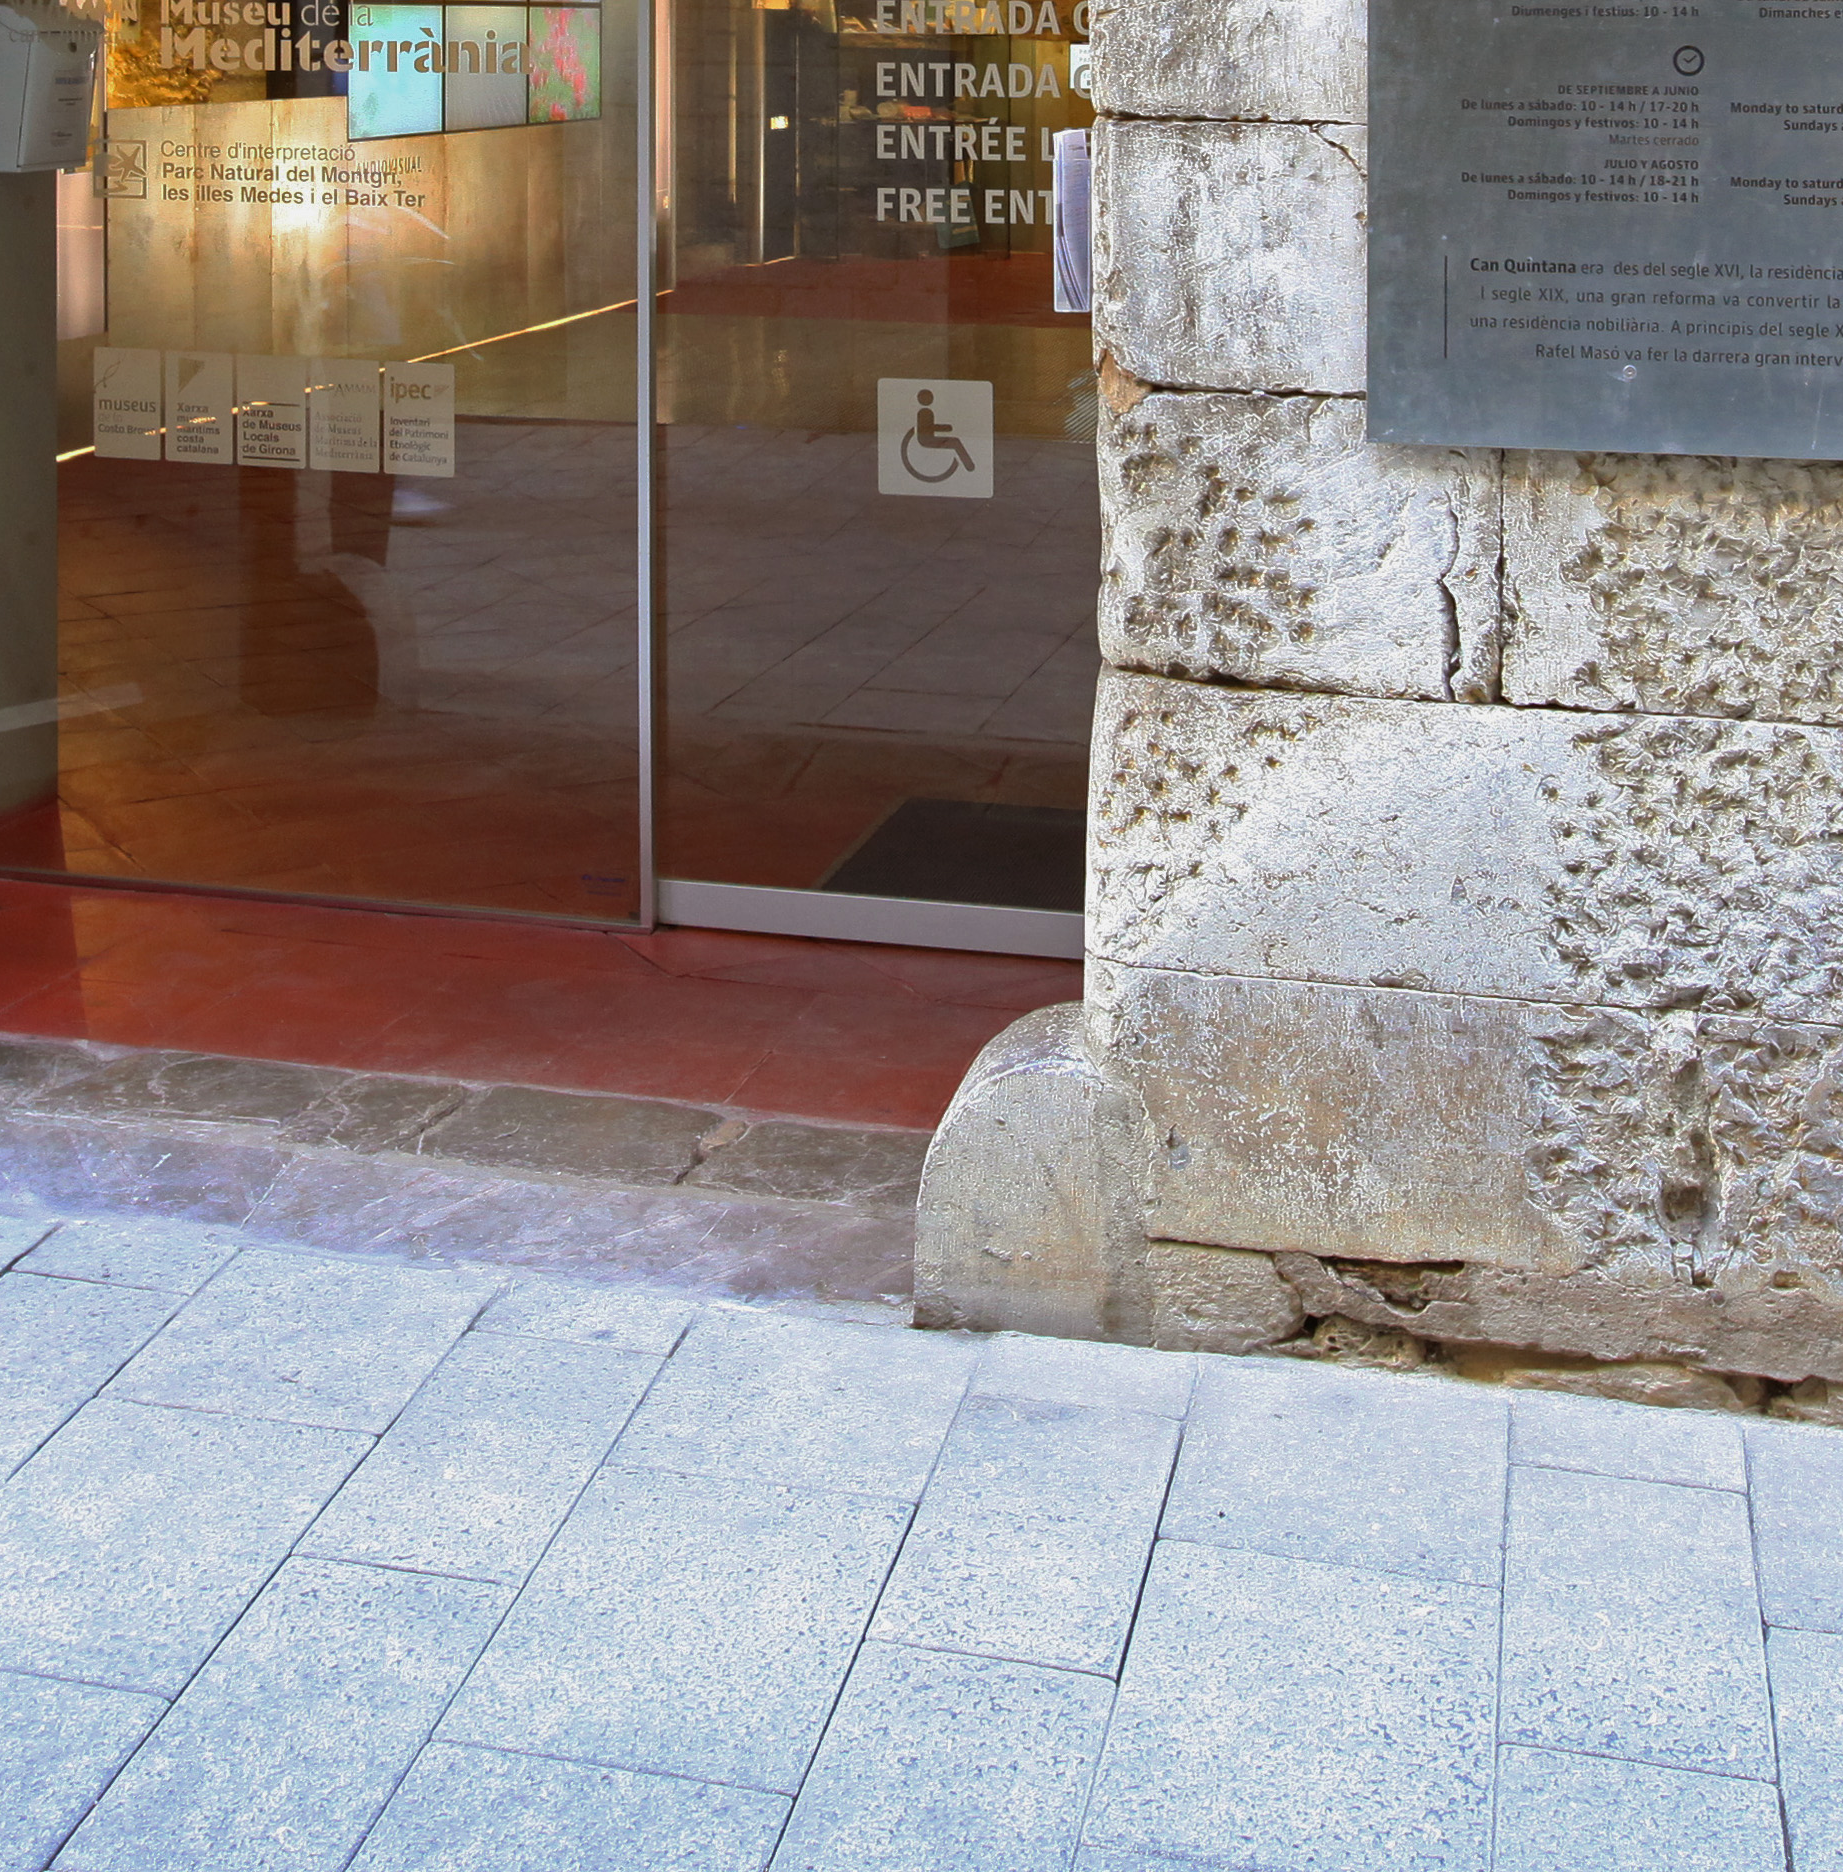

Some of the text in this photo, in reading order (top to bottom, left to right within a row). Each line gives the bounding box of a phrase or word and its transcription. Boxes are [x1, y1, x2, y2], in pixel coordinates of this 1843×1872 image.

[876, 0, 1062, 35] ENTRADA
[160, 27, 533, 74] Mediterrània
[876, 62, 1062, 99] ENTRADA
[1558, 85, 1699, 96] DE SEPTIEMBRE A JUNIO
[876, 117, 1026, 162] ENTRÉE
[1609, 134, 1699, 146] Martes cerrado
[160, 140, 356, 164] Centre d'interpretació
[1604, 159, 1699, 170] JULIO Y AGOSTO
[162, 162, 402, 188] Parc Natural del Montgrí,
[162, 184, 426, 208] les illes Medes i el Baix Ter
[876, 187, 971, 224] FREE
[1470, 258, 1499, 271] Can
[1504, 258, 1577, 274] Quintana
[1581, 263, 1604, 274] era
[1613, 262, 1639, 275] des
[1643, 262, 1666, 276] del
[1670, 262, 1710, 279] segle
[1714, 264, 1744, 280] XVI,
[1749, 264, 1763, 278] la
[1492, 287, 1532, 303] segle
[1538, 288, 1569, 304] XIX,
[1576, 292, 1604, 303] una
[1611, 293, 1646, 307] gran
[1653, 290, 1715, 306] reforma
[1723, 296, 1740, 306] va
[1747, 295, 1819, 308] convertir
[1827, 295, 1841, 309] la
[1470, 317, 1497, 328] una
[1503, 315, 1581, 331] residència
[1586, 318, 1664, 333] nobiliària.
[1670, 319, 1682, 333] A
[1686, 320, 1754, 337] principis
[1759, 322, 1783, 336] del
[1788, 323, 1830, 339] segle
[1536, 344, 1575, 359] Rafel
[1581, 345, 1620, 360] Masó
[1624, 349, 1642, 361] va
[1647, 347, 1668, 361] fer
[1674, 348, 1688, 363] la
[1692, 349, 1750, 364] darrera
[1755, 353, 1790, 367] gran
[390, 376, 432, 404] ipec
[99, 398, 157, 413] museus
[177, 402, 209, 414] Xarxa
[242, 406, 274, 418] Xarxa
[242, 419, 302, 432] de Museus
[390, 417, 431, 426] Inventari
[177, 435, 205, 444] costa
[243, 431, 280, 443] Locals
[389, 428, 449, 440] del Patrimoni
[177, 444, 219, 455] catalana
[242, 443, 296, 455] de Girona
[390, 440, 431, 452] Etnològic
[389, 452, 448, 466] de Catalunya
